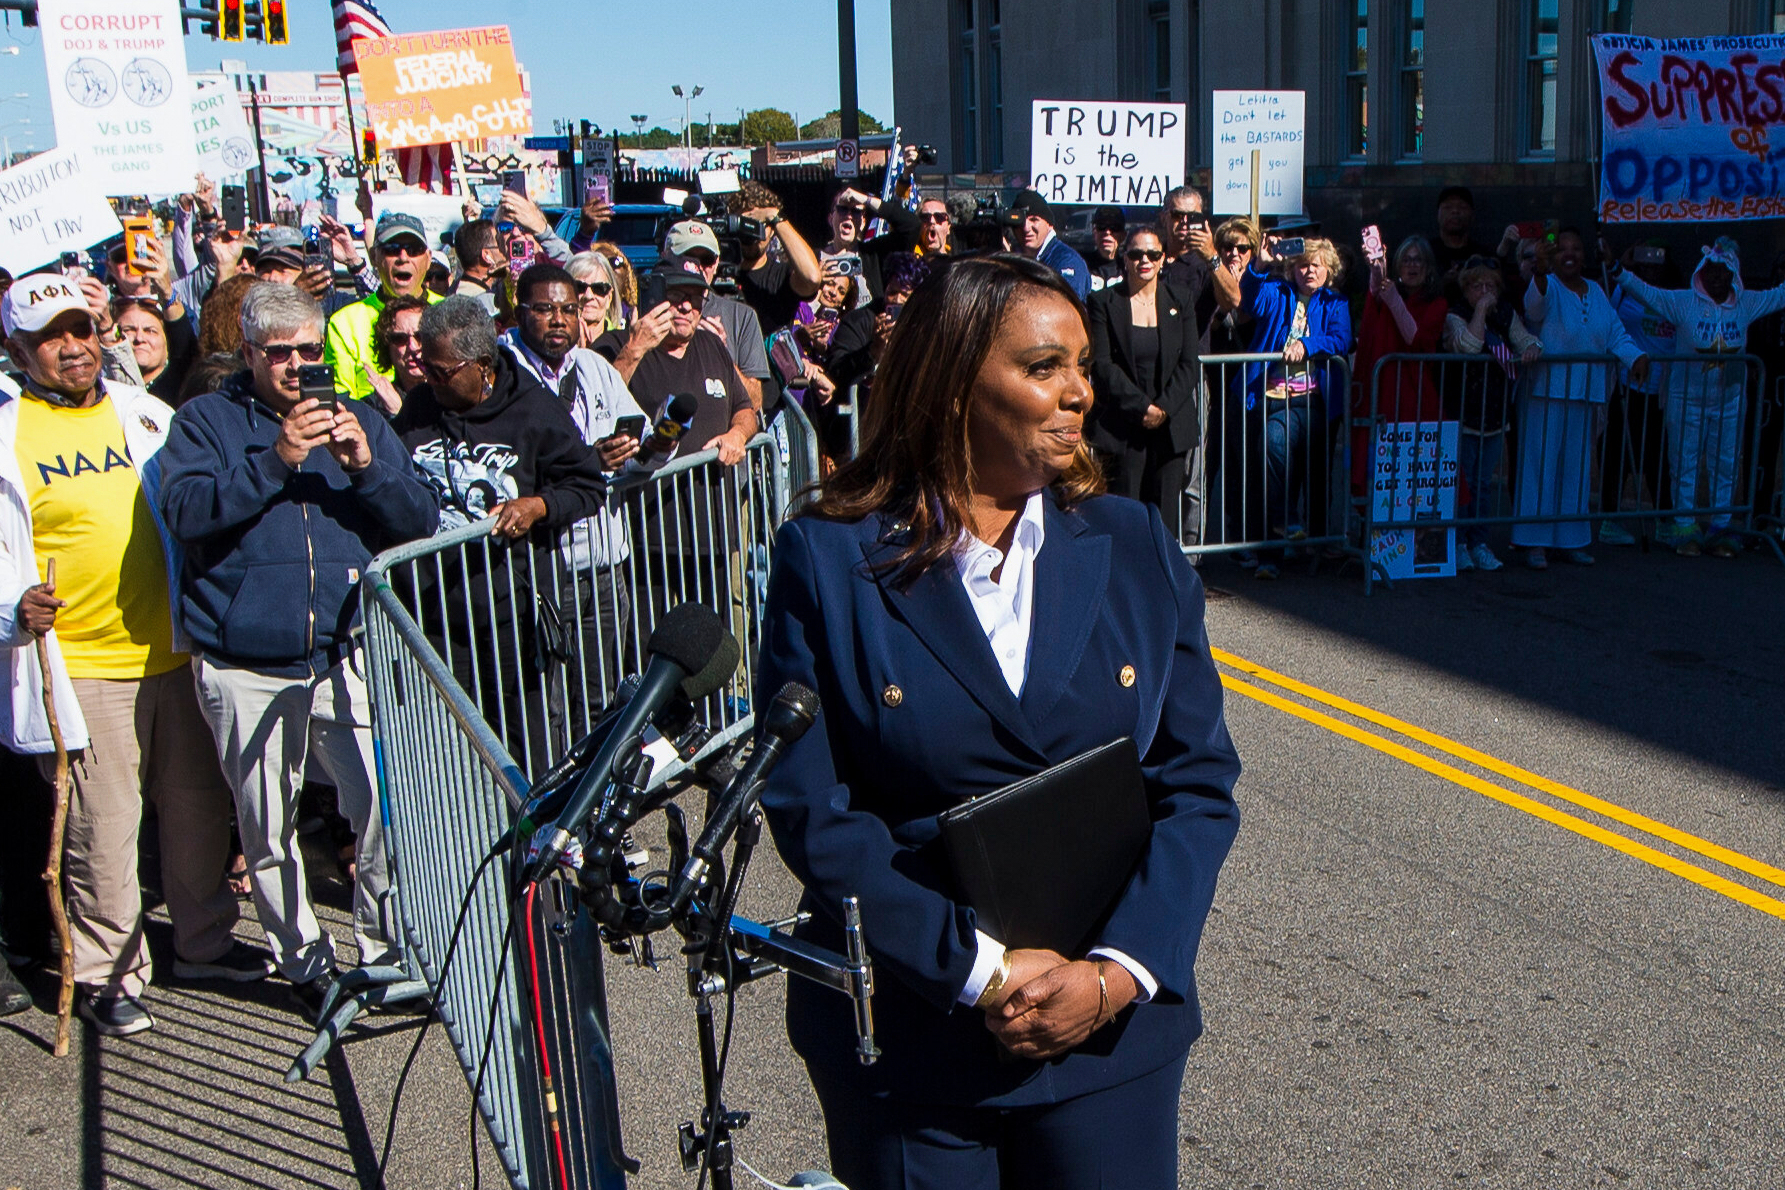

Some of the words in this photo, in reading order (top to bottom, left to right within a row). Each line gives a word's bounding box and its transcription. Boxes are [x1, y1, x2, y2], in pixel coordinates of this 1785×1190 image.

[60, 15, 163, 30] CORRUPT
[64, 39, 92, 50] DOJ
[98, 39, 108, 50] &
[114, 39, 165, 50] TRUMP
[471, 27, 511, 46] THE
[1713, 36, 1785, 51] PROSECUTI
[394, 50, 484, 76] FEDERAL
[394, 63, 493, 95] JUDICIARY
[1606, 51, 1785, 128] SUPPRES
[420, 96, 434, 113] A
[1239, 94, 1279, 106] Letitia
[1040, 107, 1178, 138] TRUMP
[1223, 109, 1255, 124] Don't
[1268, 109, 1286, 120] let
[98, 121, 120, 136] Vs
[125, 119, 152, 135] US
[373, 112, 479, 147] KANGAROO
[586, 141, 610, 150] STOP
[1220, 132, 1236, 144] the
[1246, 130, 1303, 143] BASTARDS
[1730, 125, 1770, 163] of
[92, 145, 119, 156] THE
[121, 143, 164, 155] JAMES
[1055, 143, 1075, 165] is
[1097, 144, 1139, 169] the
[111, 161, 150, 173] GANG
[1228, 155, 1244, 171] get
[1268, 160, 1288, 171] you
[0, 152, 81, 211] RIBUTION
[1226, 180, 1248, 190] down
[1702, 195, 1739, 218] the
[9, 206, 43, 235] NOT
[42, 215, 82, 245] LAW
[1379, 431, 1412, 443] COME
[473, 443, 519, 480] Trip
[1377, 462, 1400, 474] YOU
[1442, 461, 1457, 472] TO
[1375, 479, 1400, 491] GET
[1381, 496, 1402, 508] AL
[1379, 544, 1406, 565] ING
